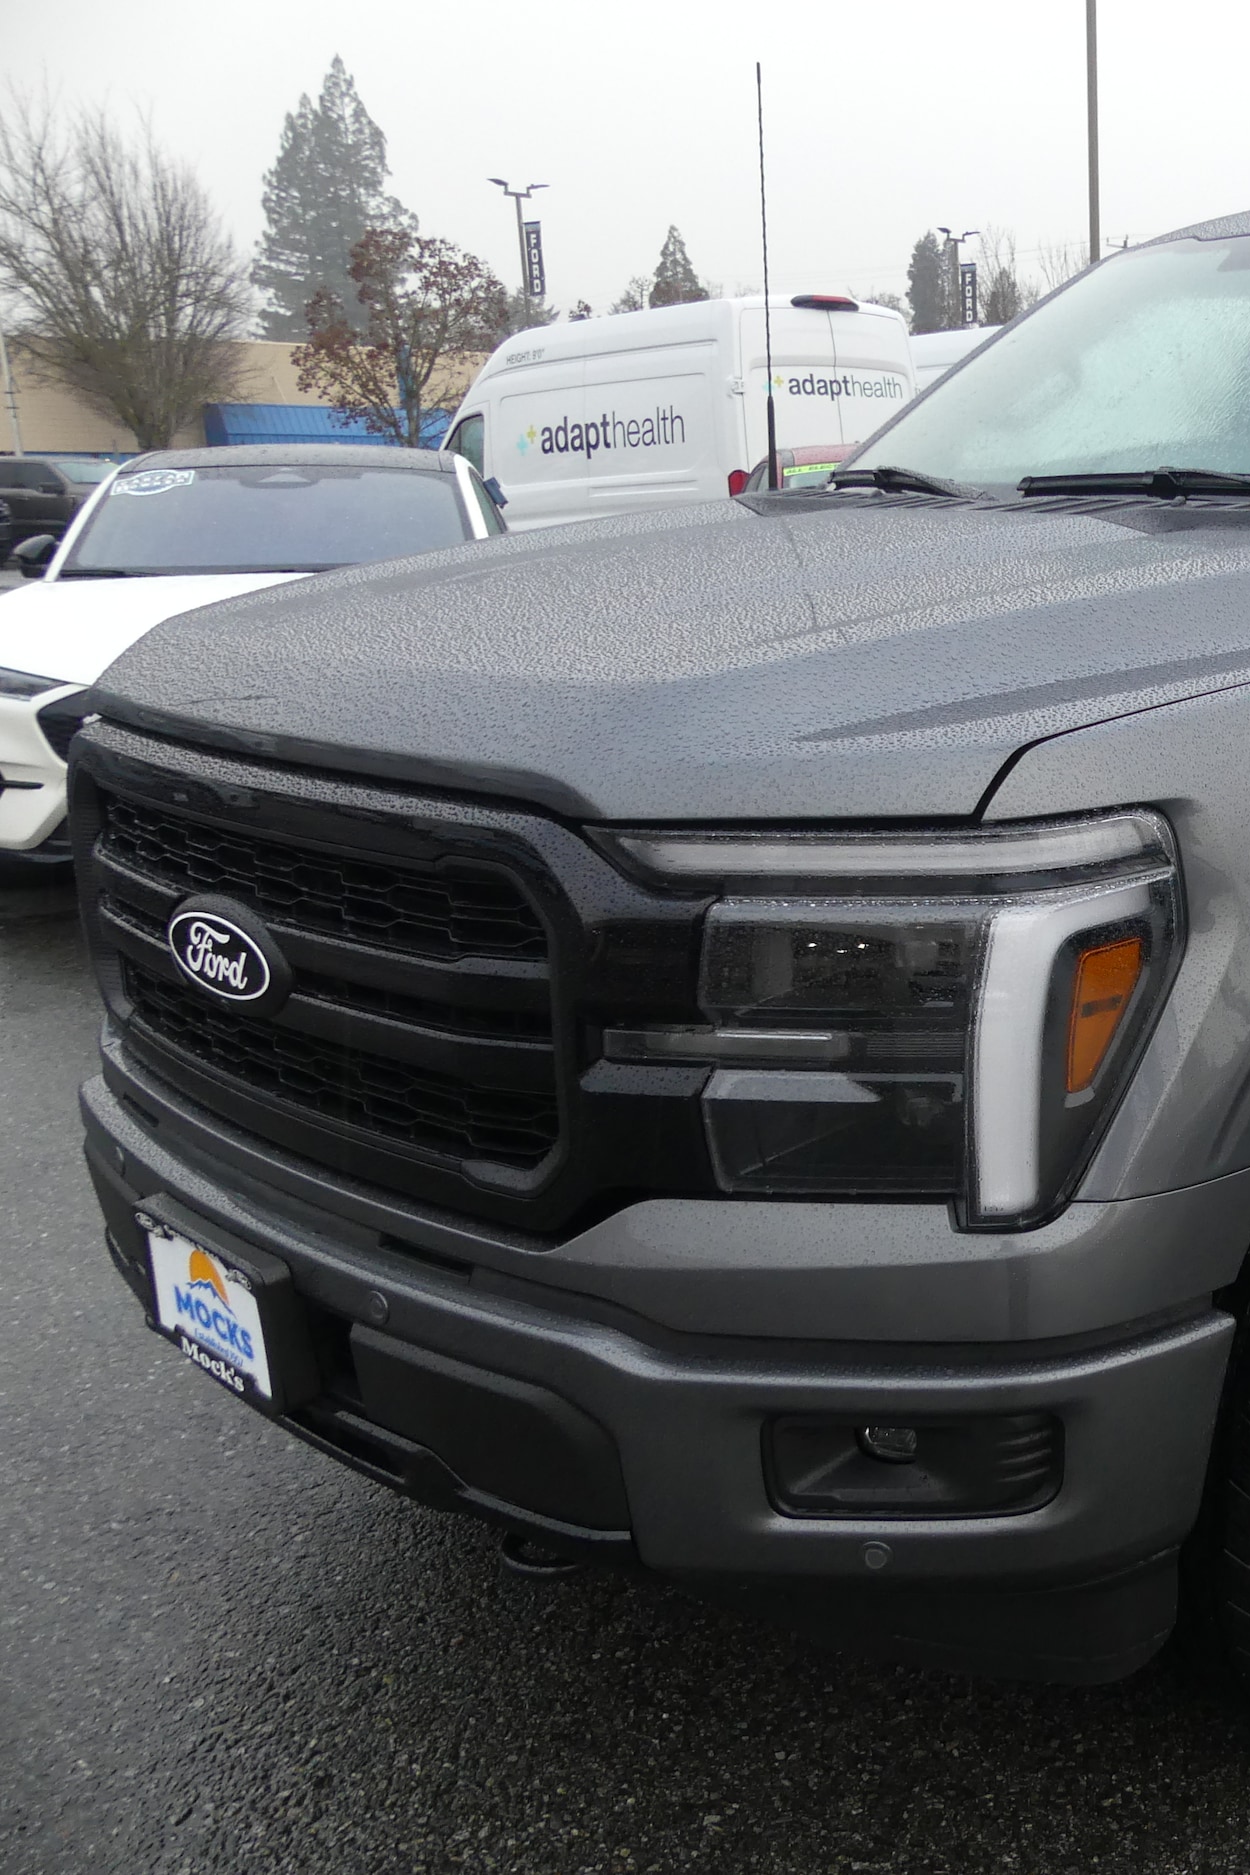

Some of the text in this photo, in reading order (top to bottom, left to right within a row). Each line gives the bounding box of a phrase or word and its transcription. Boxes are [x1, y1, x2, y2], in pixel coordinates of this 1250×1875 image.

[530, 233, 541, 293] FORD
[965, 273, 974, 322] FORD
[788, 373, 903, 401] adapthealth
[540, 404, 686, 460] adapthealth
[187, 921, 248, 989] Ford
[174, 1284, 255, 1359] MOCKS
[181, 1335, 244, 1392] Mock's
